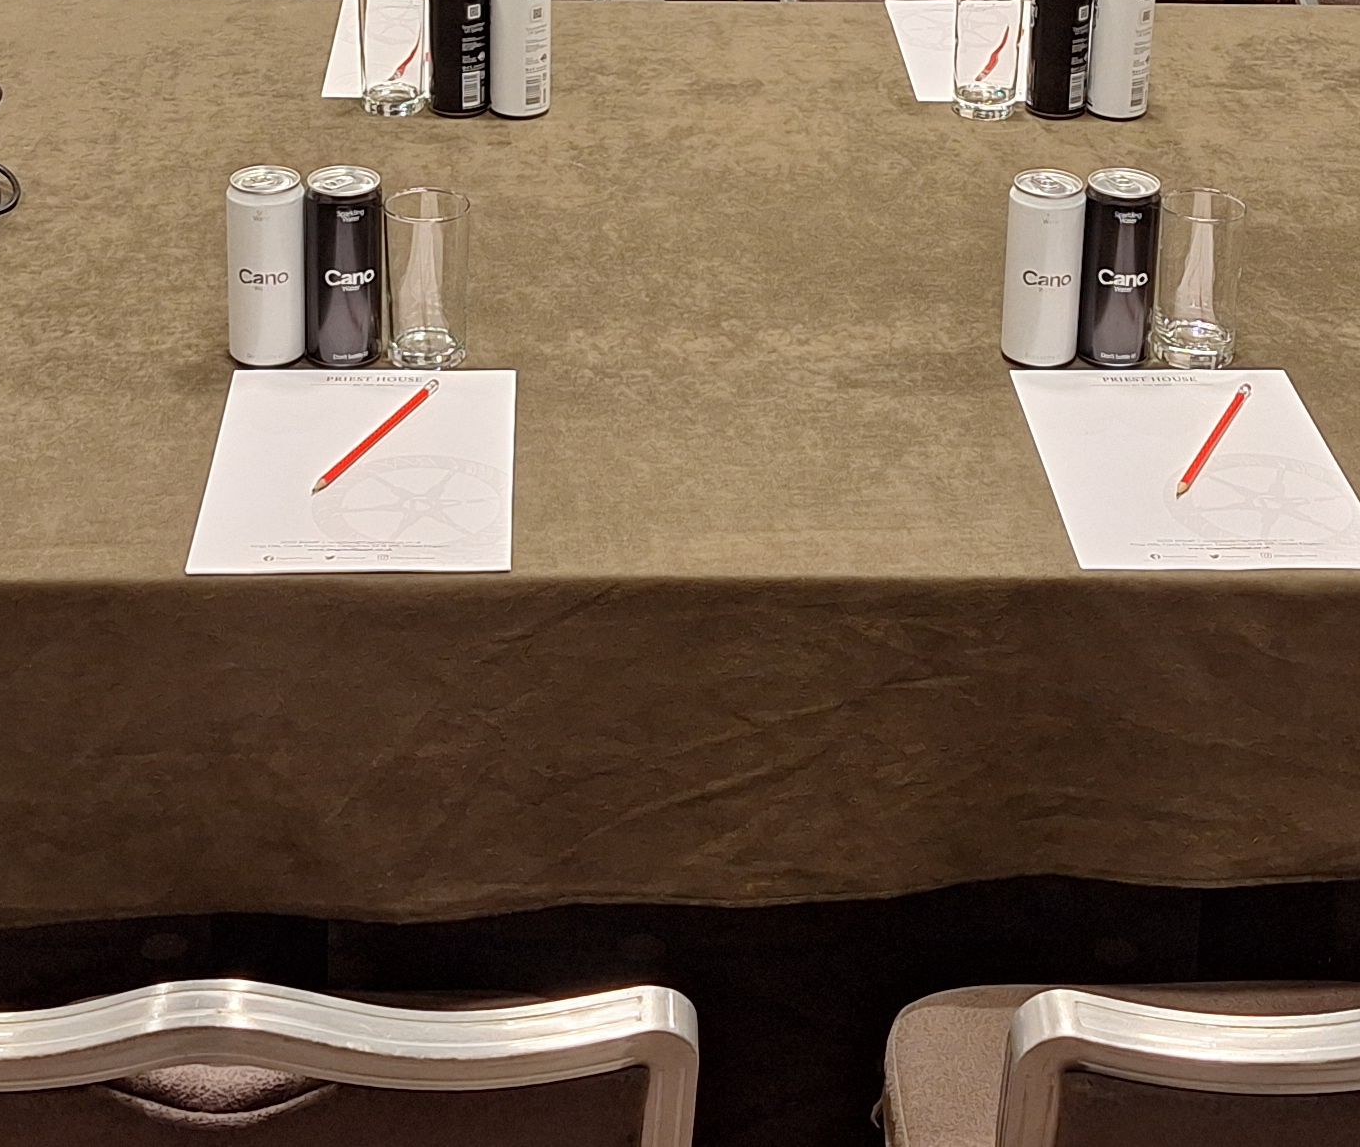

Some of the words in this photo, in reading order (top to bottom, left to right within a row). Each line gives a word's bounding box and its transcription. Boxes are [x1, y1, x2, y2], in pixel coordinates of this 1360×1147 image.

[238, 268, 289, 285] Cano
[324, 269, 376, 287] Cano
[1022, 270, 1072, 287] Cano
[1097, 268, 1149, 288] Cano
[325, 375, 372, 383] PRIEST
[375, 375, 424, 383] HOUSE
